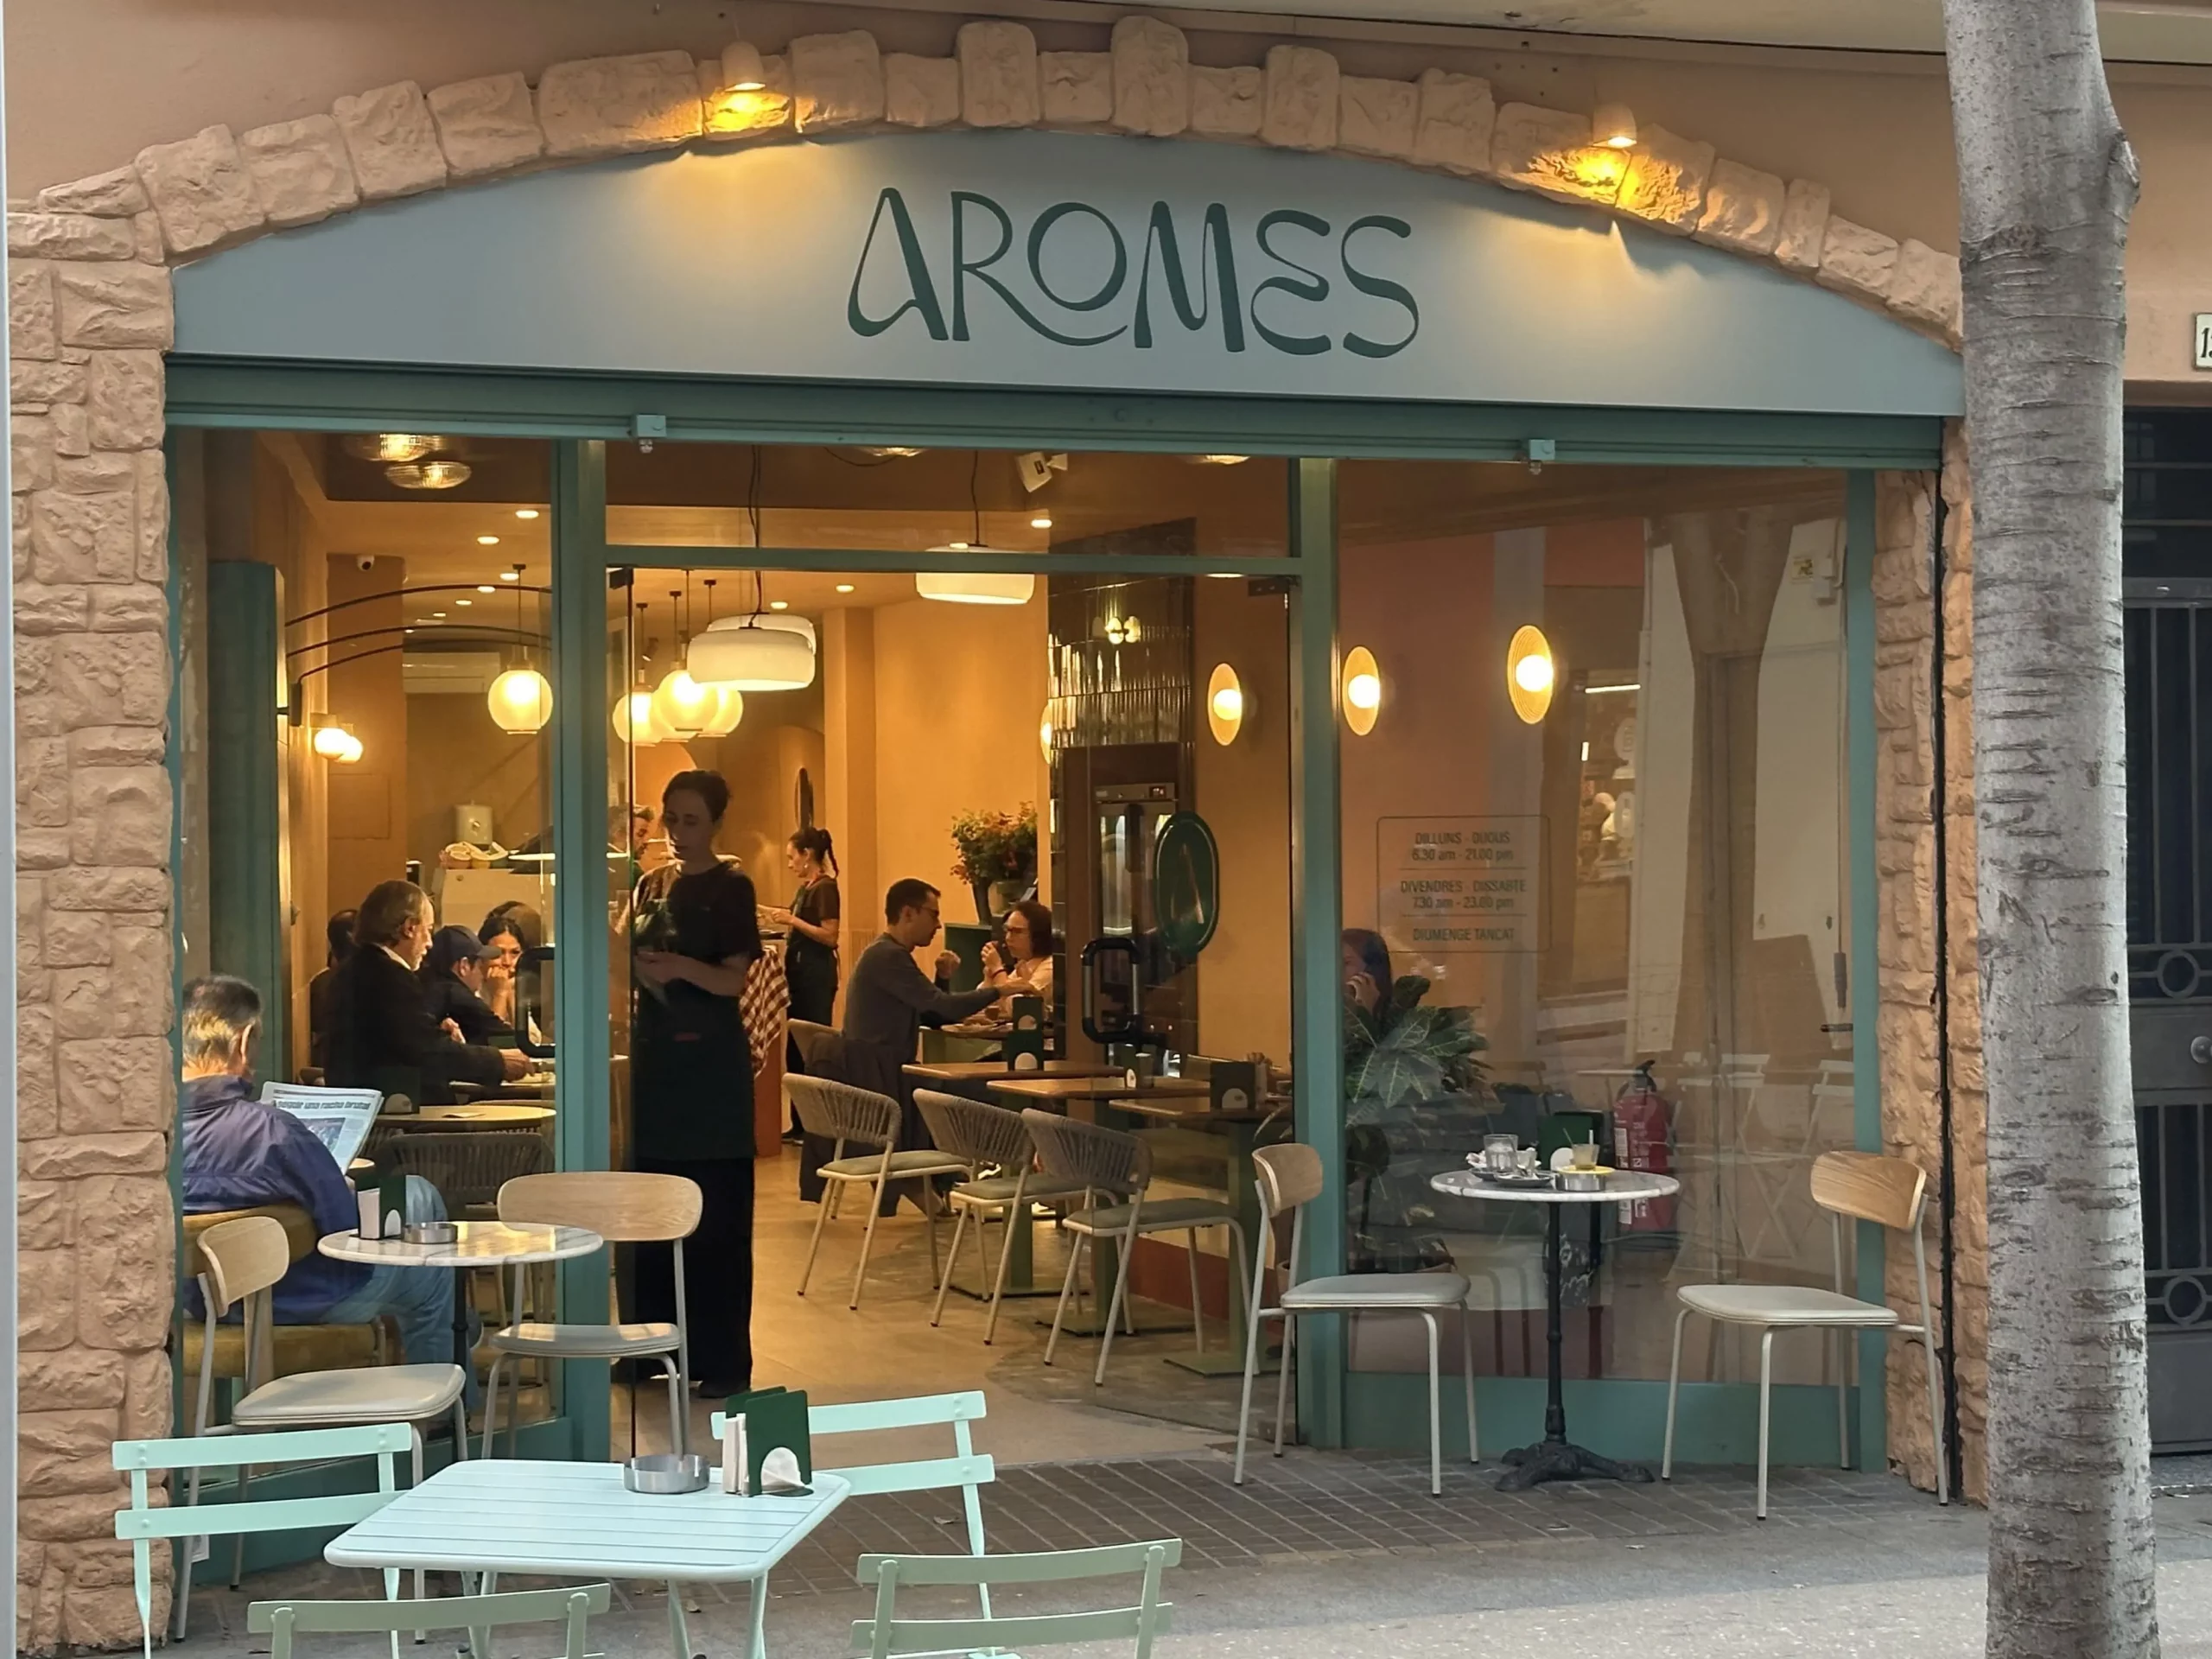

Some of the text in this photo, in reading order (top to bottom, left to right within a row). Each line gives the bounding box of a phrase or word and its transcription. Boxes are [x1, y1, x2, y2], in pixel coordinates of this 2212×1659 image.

[848, 187, 1420, 359] AROMES
[2200, 327, 2212, 359] 1
[1415, 832, 1462, 844] DILLUNS
[1471, 831, 1510, 844] DIJOUS
[1438, 850, 1456, 861] am
[1496, 849, 1514, 862] pm
[1401, 880, 1463, 893] DIVENDRES
[1472, 880, 1527, 893] DISSABTE
[1413, 928, 1515, 941] DIUMENGE TANCAT
